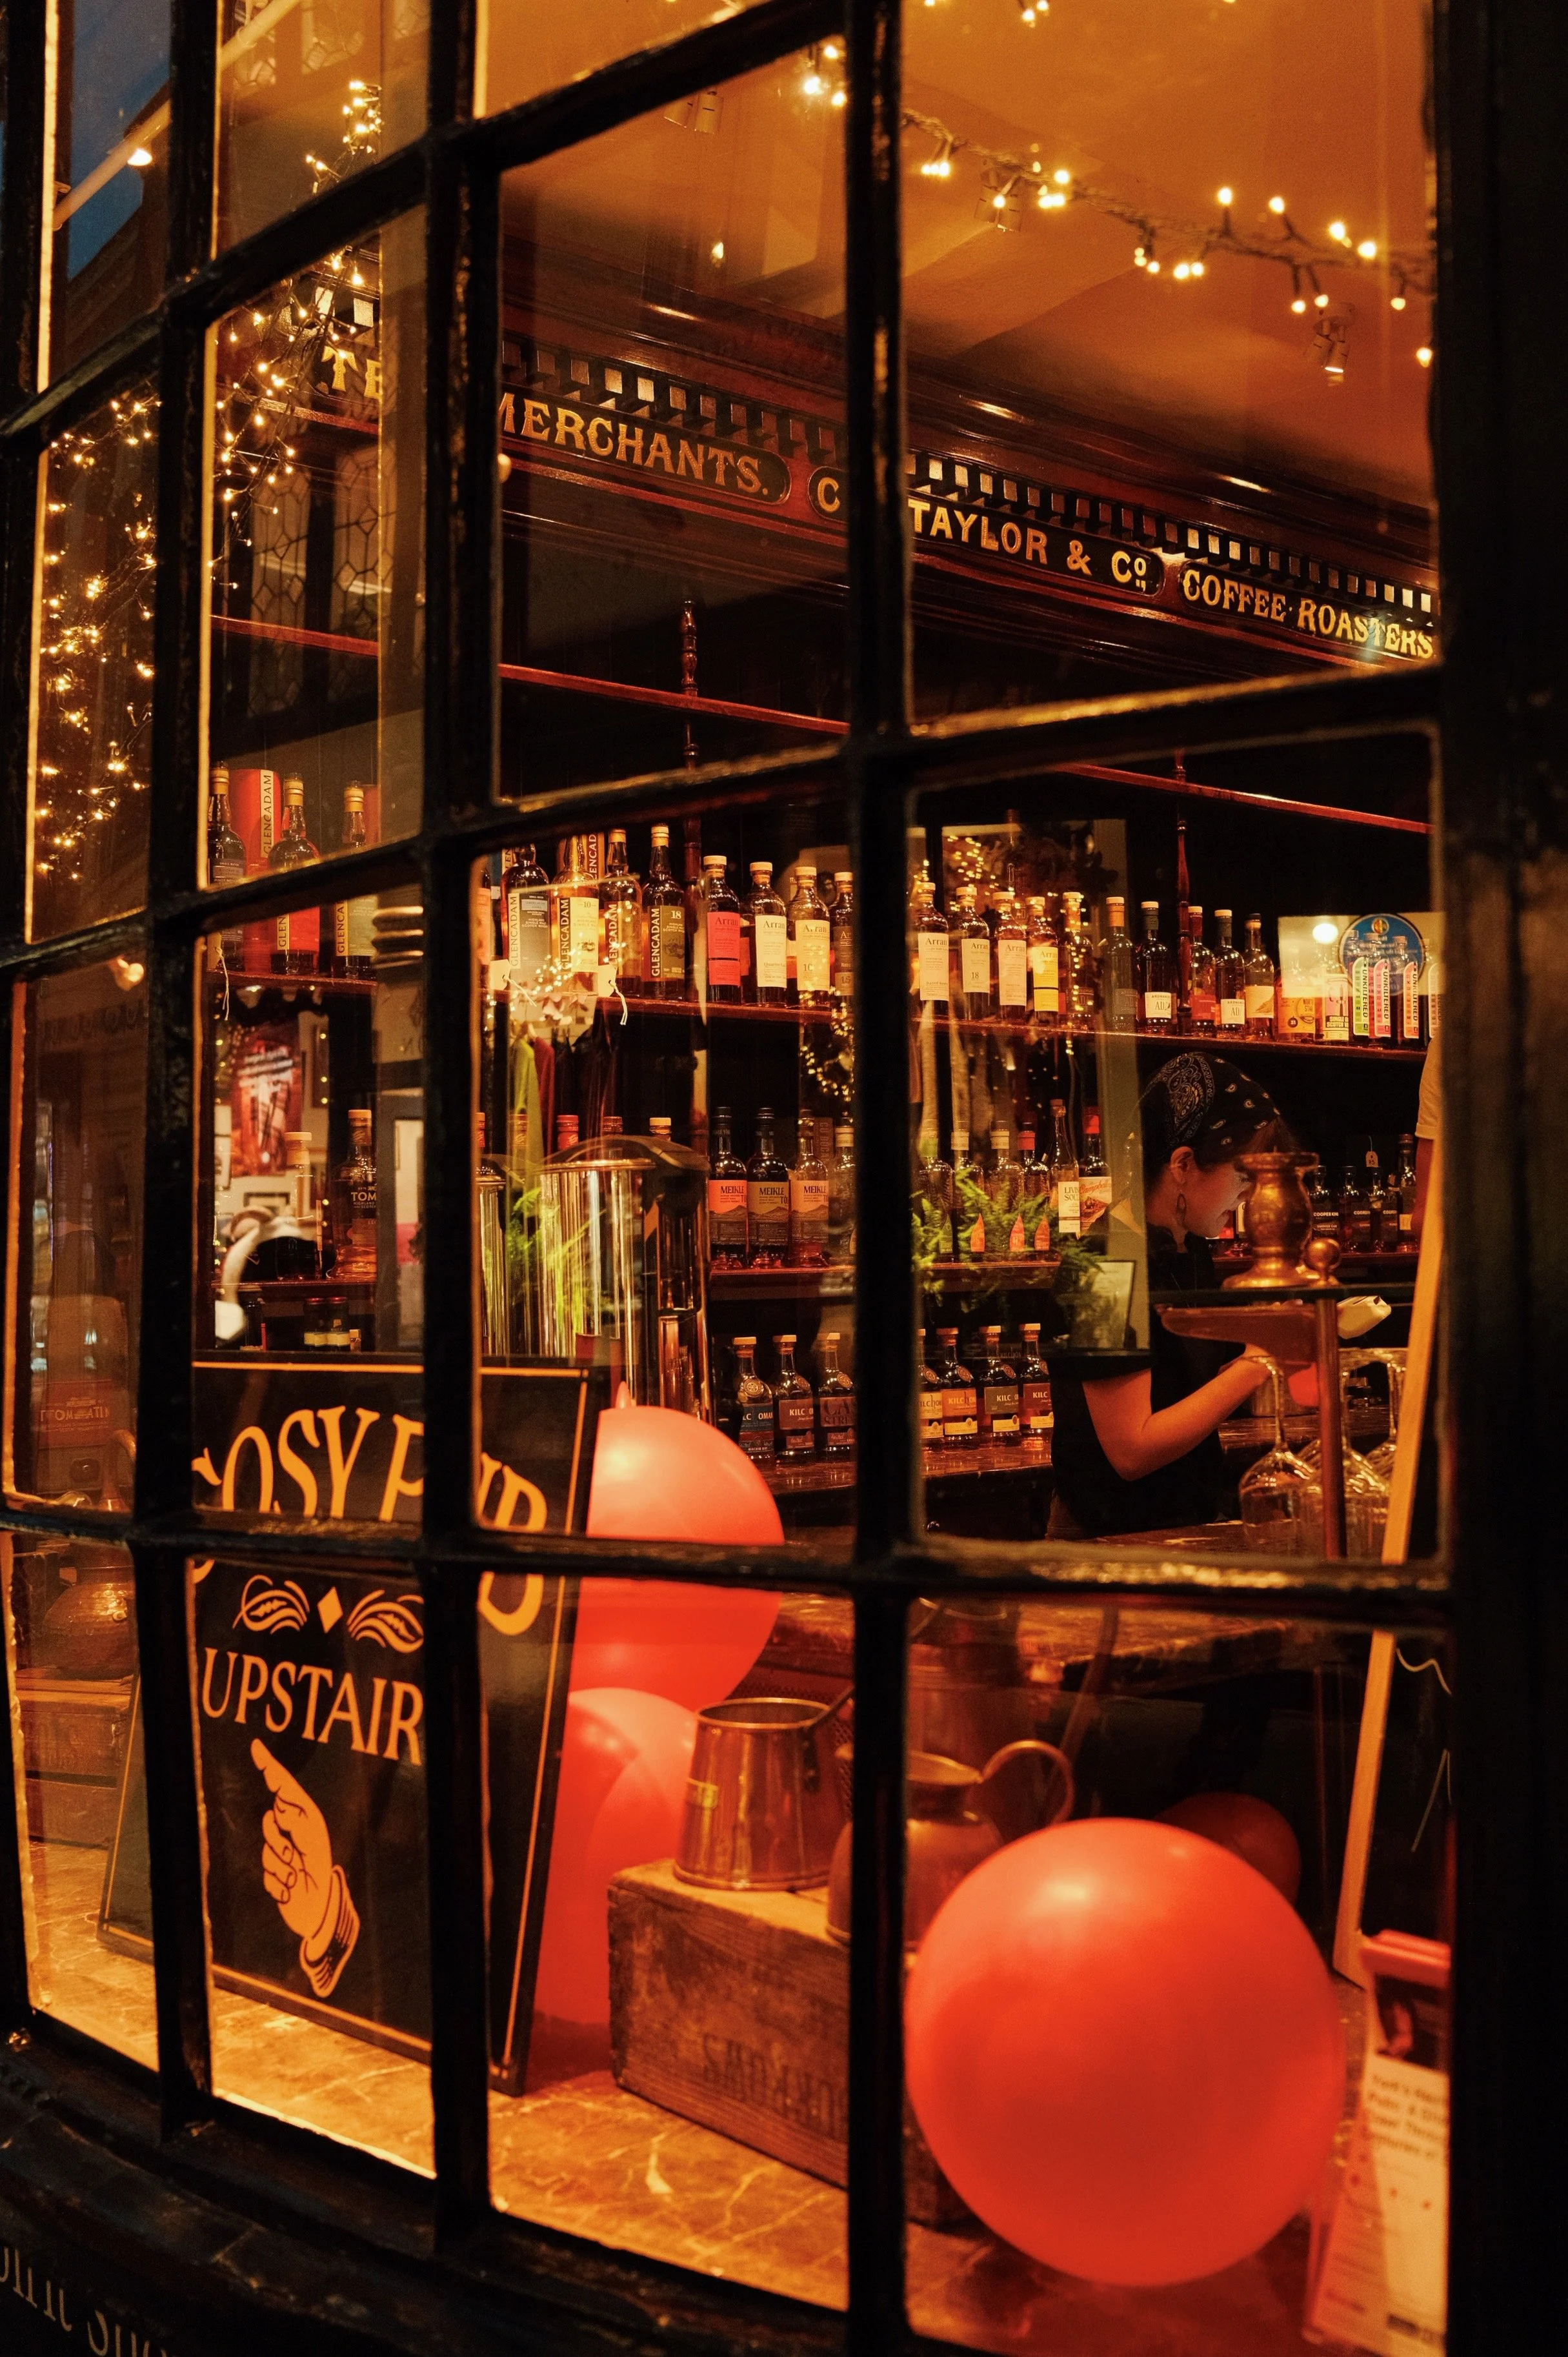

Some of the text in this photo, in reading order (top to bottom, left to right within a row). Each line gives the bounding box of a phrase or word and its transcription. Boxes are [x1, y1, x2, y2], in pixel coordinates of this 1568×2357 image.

[908, 499, 1048, 565] TAYLOR
[1067, 540, 1093, 576] &
[1183, 569, 1434, 660] COFFEE ROASTERS
[263, 774, 272, 855] GLENCADAM
[561, 899, 569, 970] GLENCADAM
[651, 908, 660, 976] GLENCADAM
[671, 911, 681, 919] 18
[715, 917, 739, 926] Arran
[763, 921, 785, 929] Arran
[759, 1187, 785, 1195] MEIKLE
[202, 1647, 423, 1766] UPSTAIR
